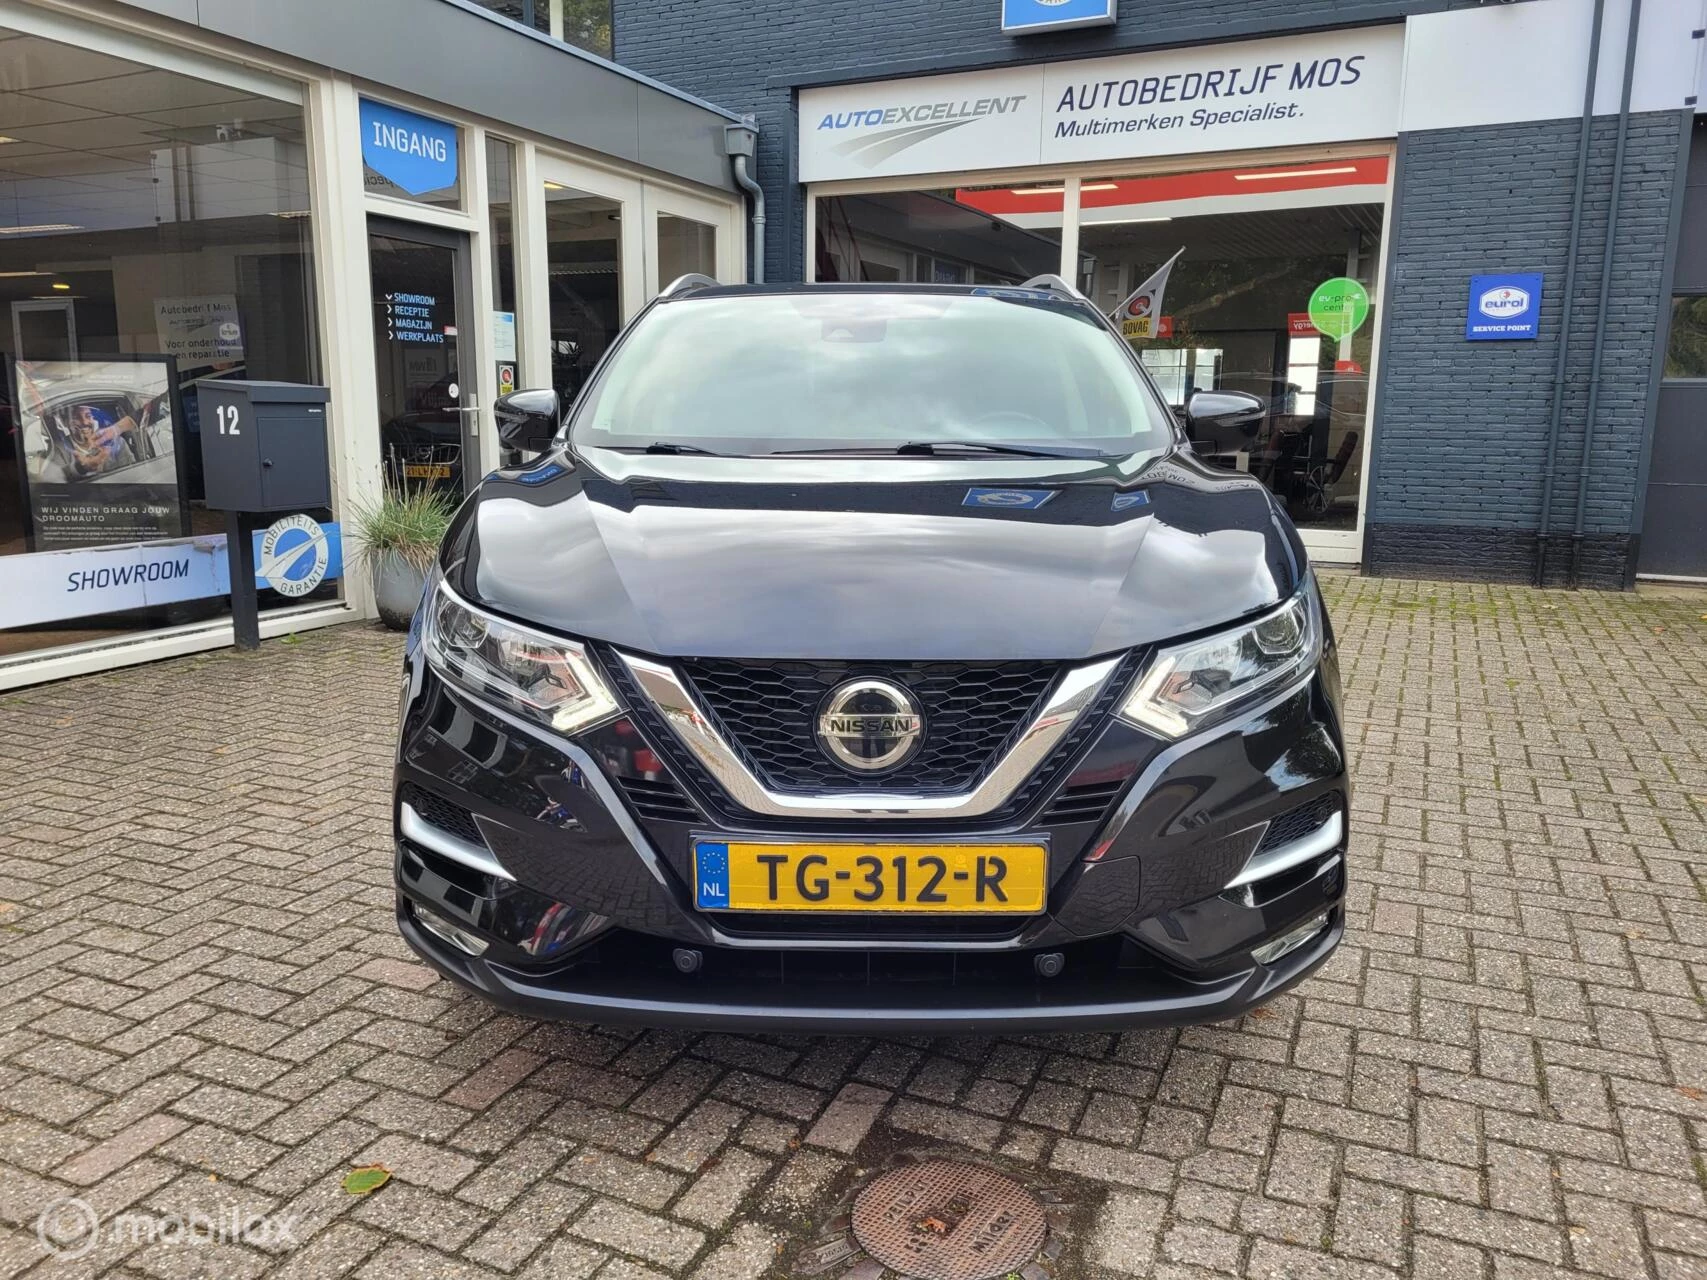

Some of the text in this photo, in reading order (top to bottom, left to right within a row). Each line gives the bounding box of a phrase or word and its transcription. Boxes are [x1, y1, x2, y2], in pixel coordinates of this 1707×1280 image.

[1056, 55, 1366, 113] AUTOBEDRIJF MOS
[816, 95, 1028, 131] AUTOEXCELLENT
[1054, 101, 1305, 138] Multimerken Specialist.
[372, 121, 447, 163] INGANG
[393, 292, 436, 306] SHOWROOM
[1485, 297, 1524, 309] eurol
[394, 305, 430, 318] RECEPTIE
[395, 318, 433, 330] MAGAZIJN
[1122, 320, 1149, 335] BOVAG
[1472, 324, 1532, 333] SERVICE POINT
[396, 330, 444, 344] WERKPLAATS
[216, 404, 241, 436] 12
[41, 506, 170, 514] WIJ VINDEN GRAAG JOUW
[42, 514, 105, 523] DROOMAUTO
[263, 516, 320, 556] MOBILITEITS
[67, 558, 190, 592] SHOWROOM
[280, 557, 327, 596] GARANTIE
[830, 718, 912, 733] NISSAN
[756, 854, 1009, 904] TG-312-R
[702, 882, 726, 898] NL
